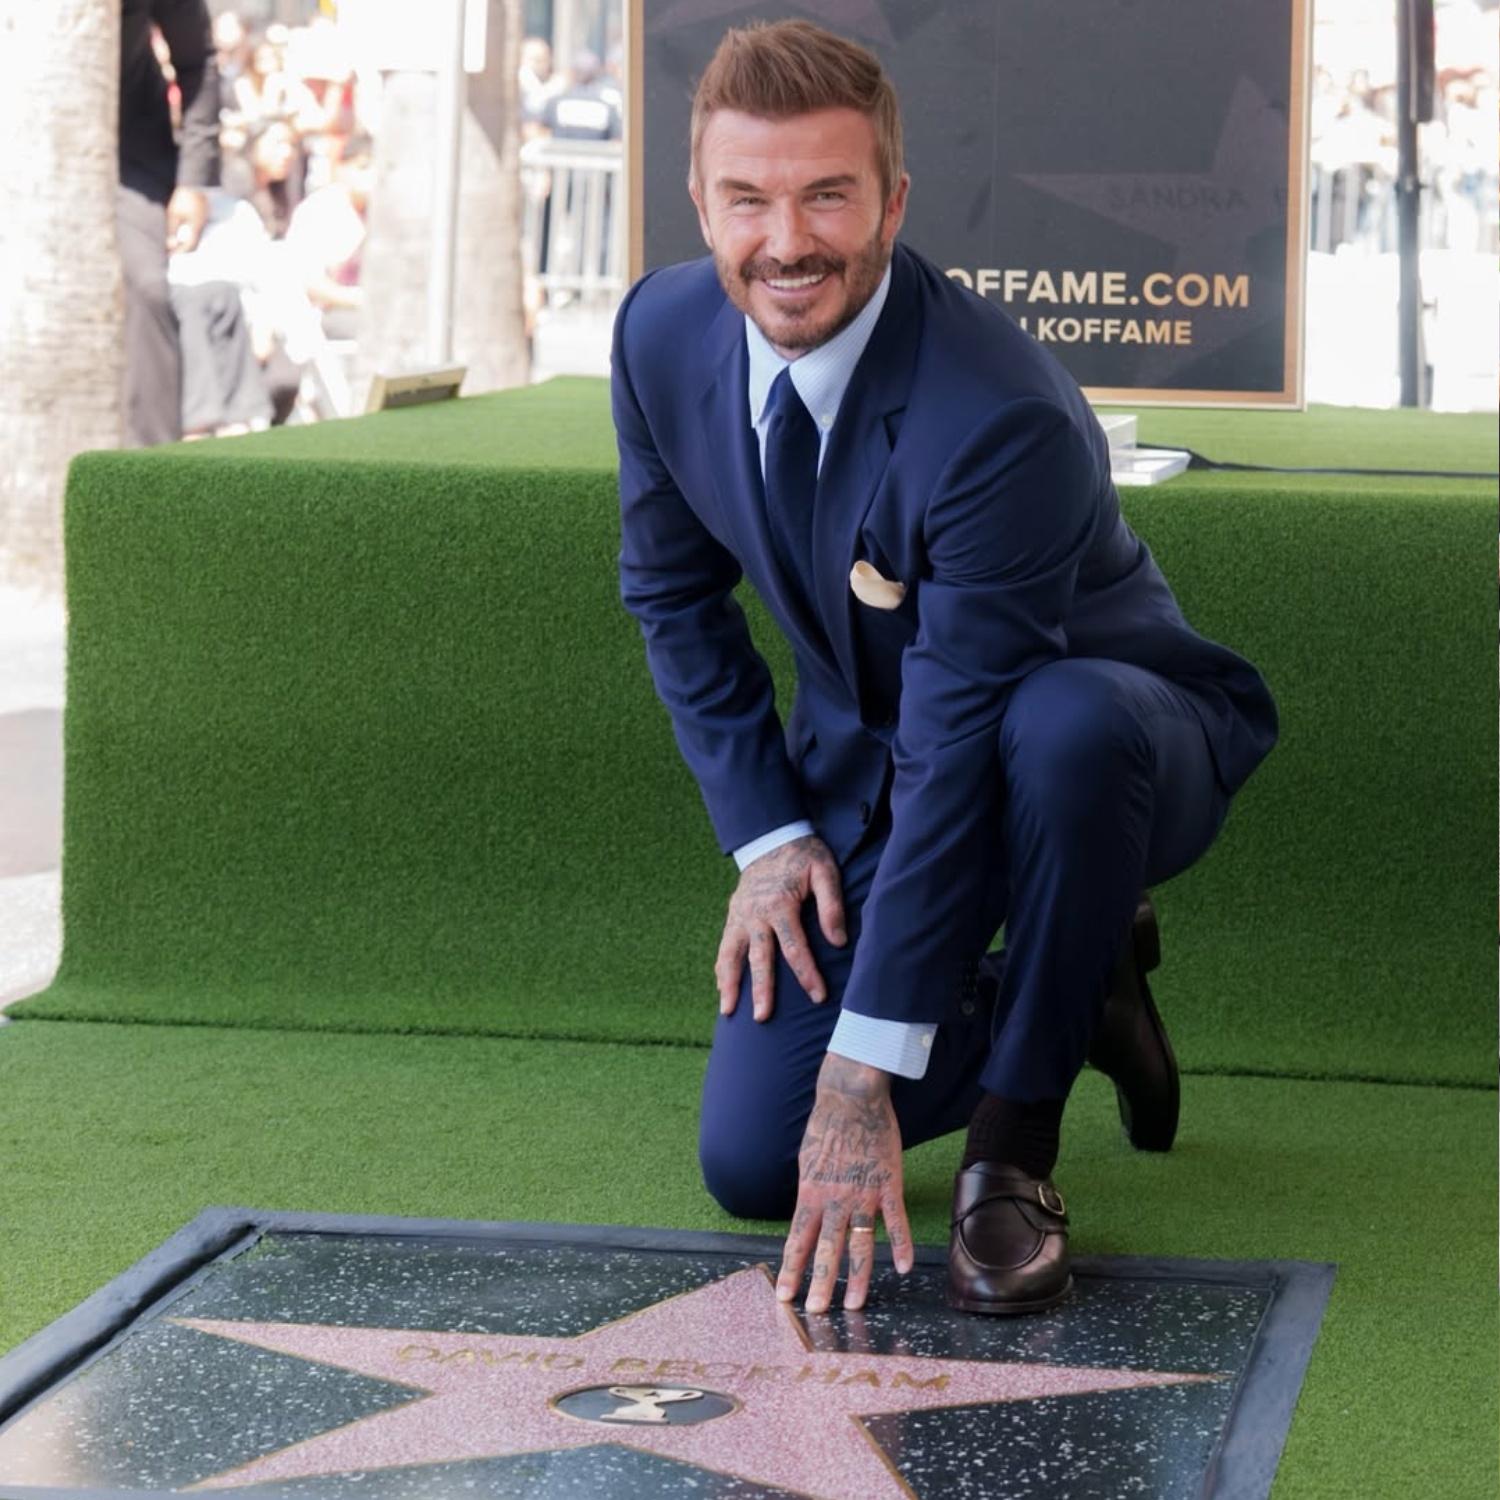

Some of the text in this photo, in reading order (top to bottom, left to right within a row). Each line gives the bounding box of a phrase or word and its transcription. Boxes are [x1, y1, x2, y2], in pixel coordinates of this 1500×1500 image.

[1107, 184, 1249, 212] SANDRA
[396, 1344, 950, 1389] DAVID BECKHAM
